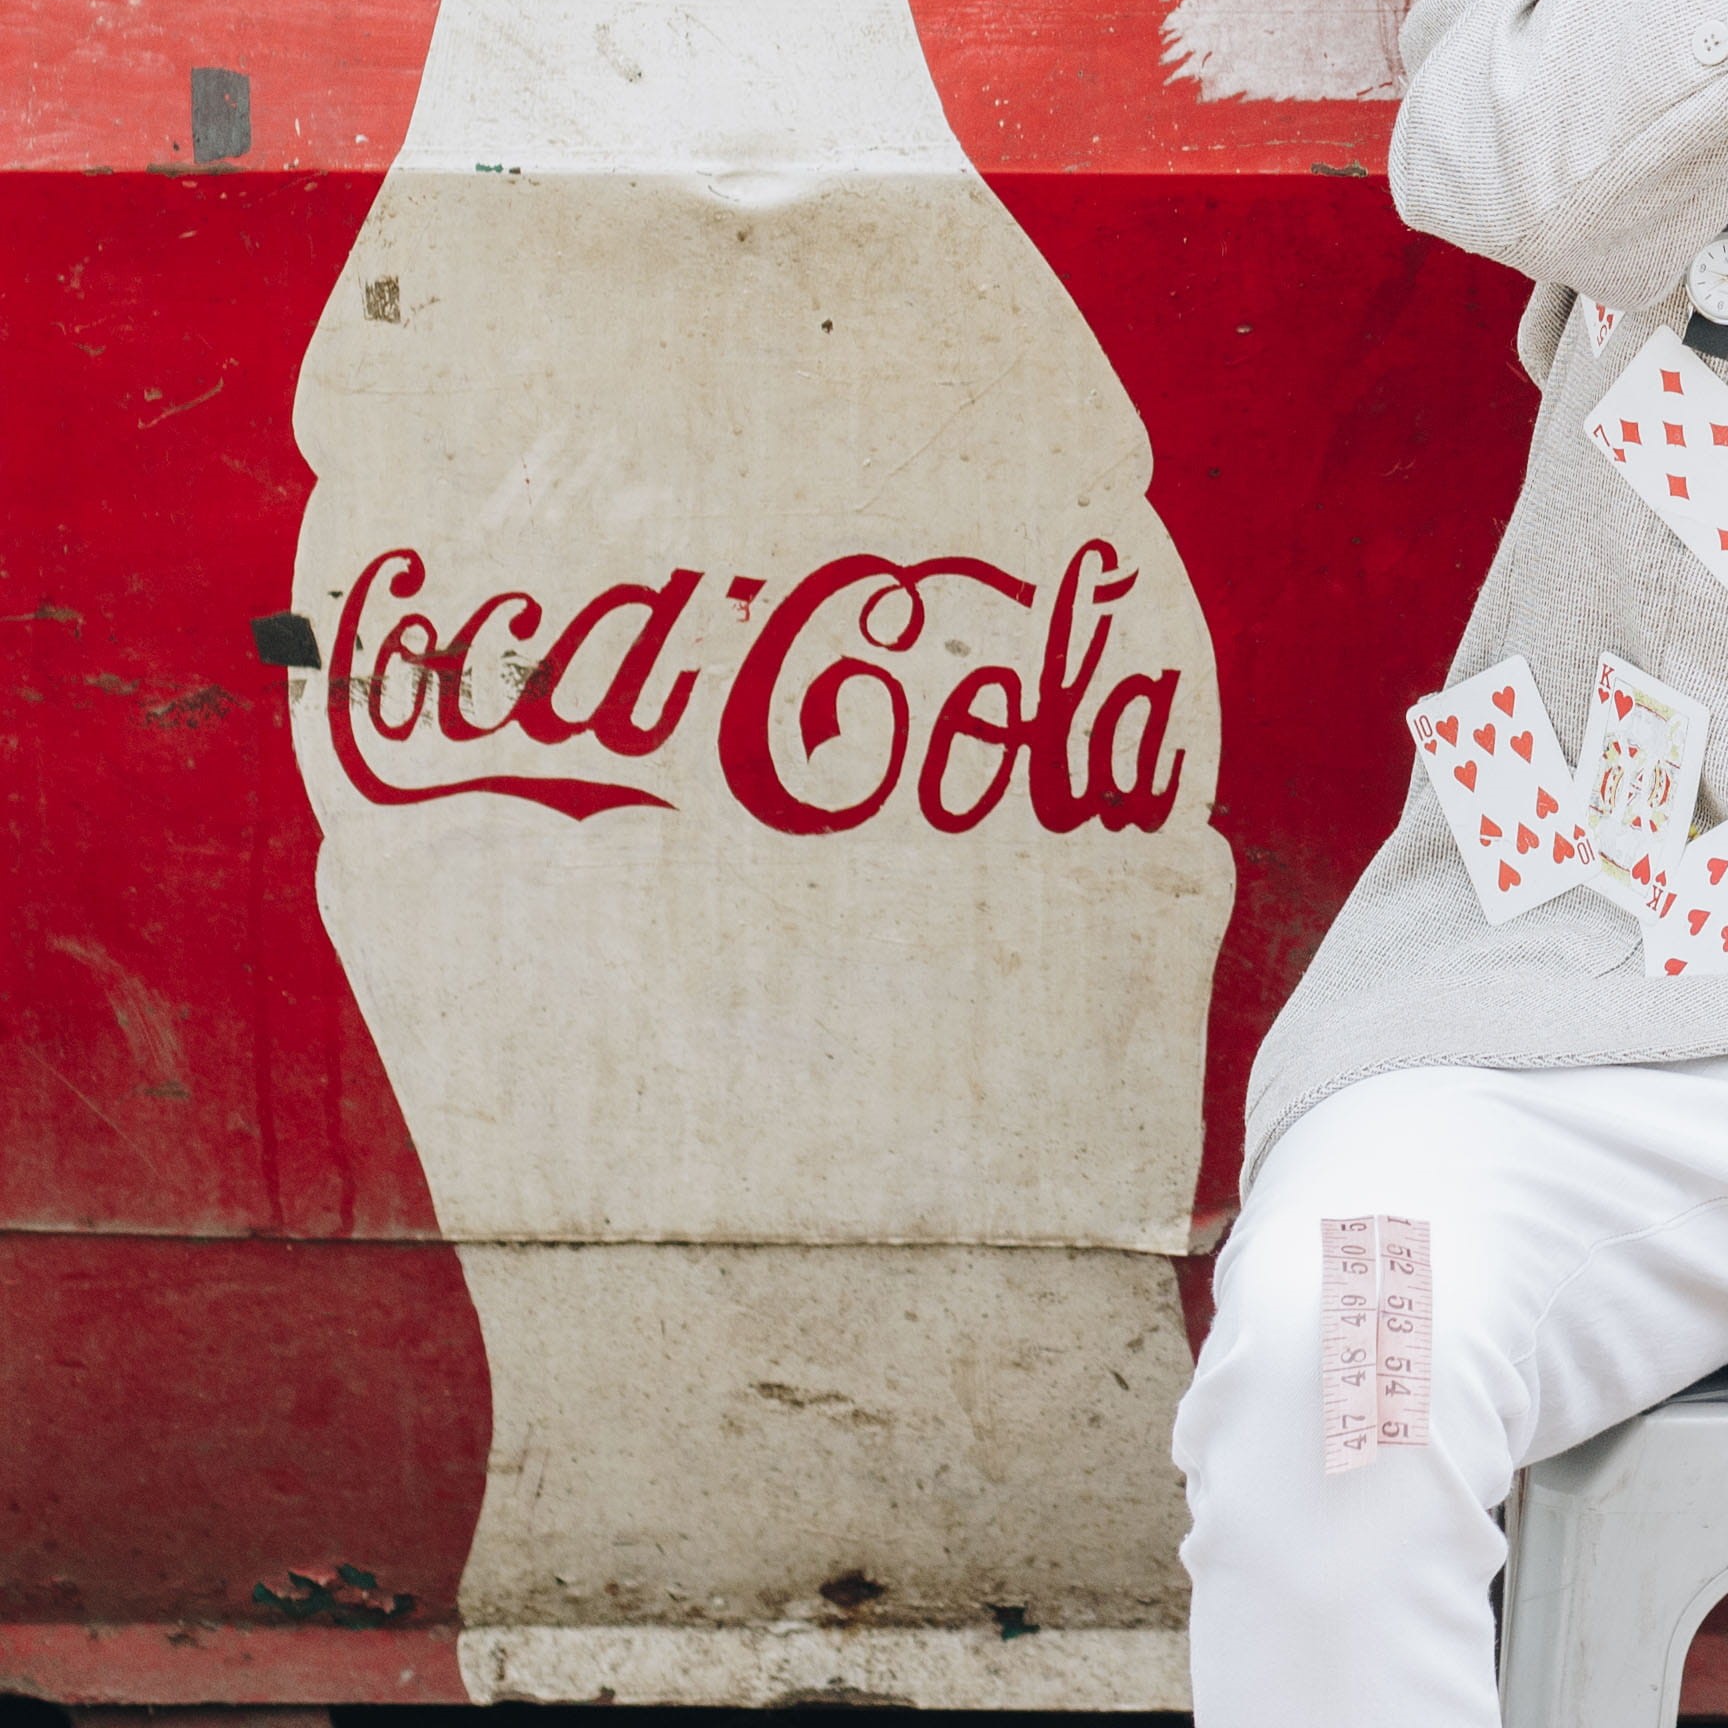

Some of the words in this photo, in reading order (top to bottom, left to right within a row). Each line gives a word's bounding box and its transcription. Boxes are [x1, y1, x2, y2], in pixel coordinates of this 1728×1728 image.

[1592, 424, 1607, 446] 7
[1599, 663, 1616, 688] K
[1413, 714, 1434, 742] 10
[1576, 839, 1598, 866] 10
